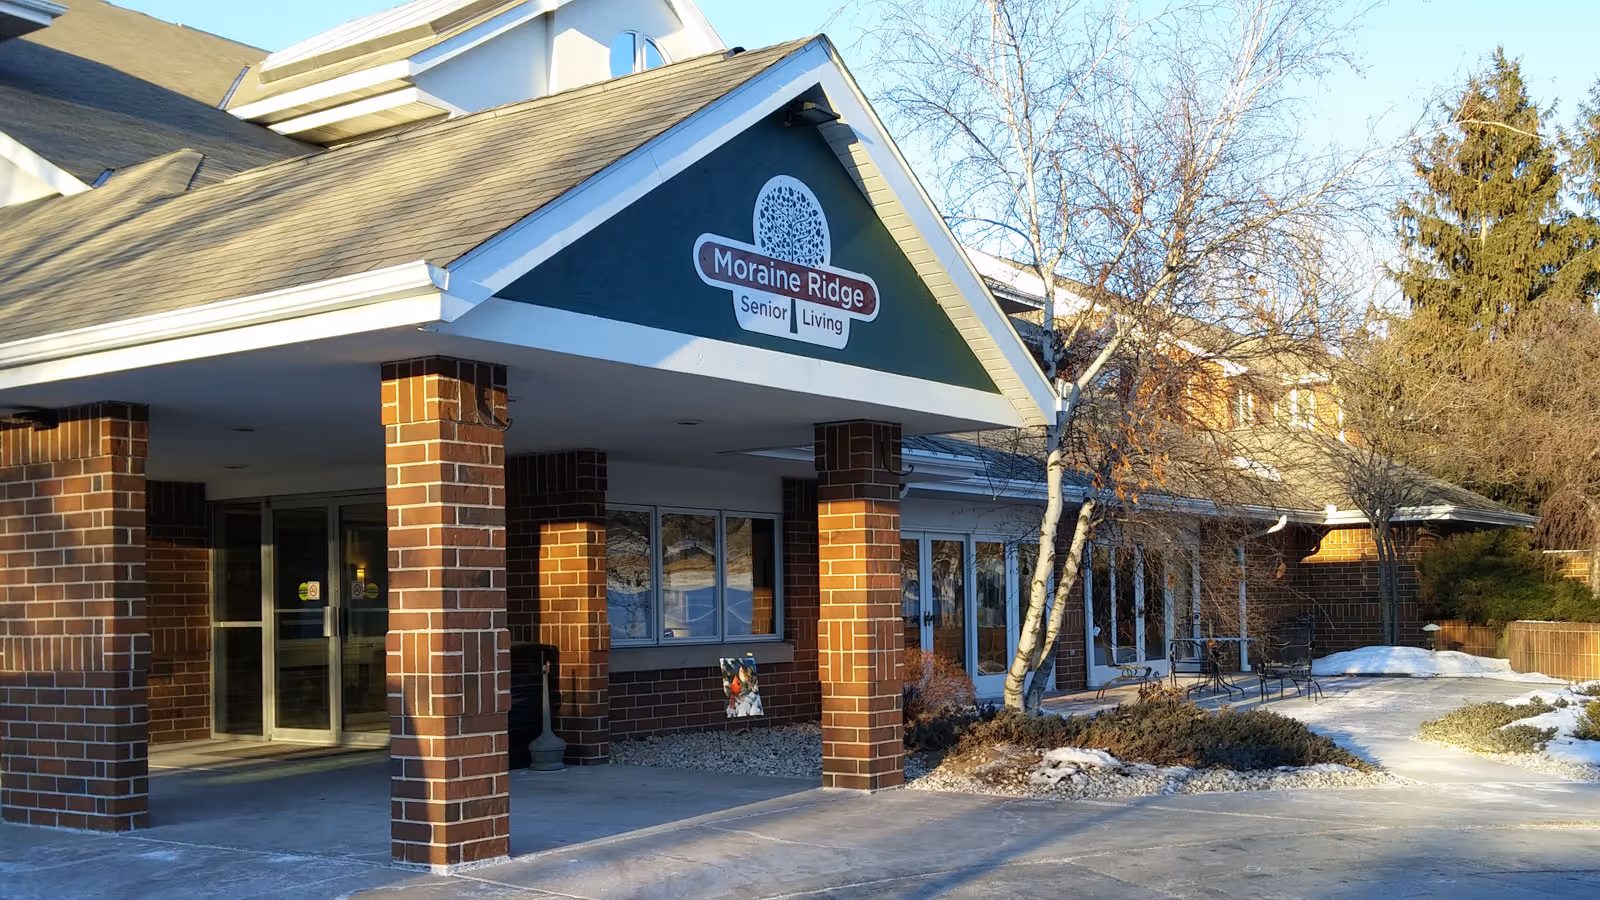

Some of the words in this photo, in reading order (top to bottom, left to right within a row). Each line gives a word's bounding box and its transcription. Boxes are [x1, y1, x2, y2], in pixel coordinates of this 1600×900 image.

[714, 248, 800, 292] Moraine
[808, 271, 864, 309] Ridge
[741, 295, 787, 320] Senior
[802, 309, 843, 335] Living
